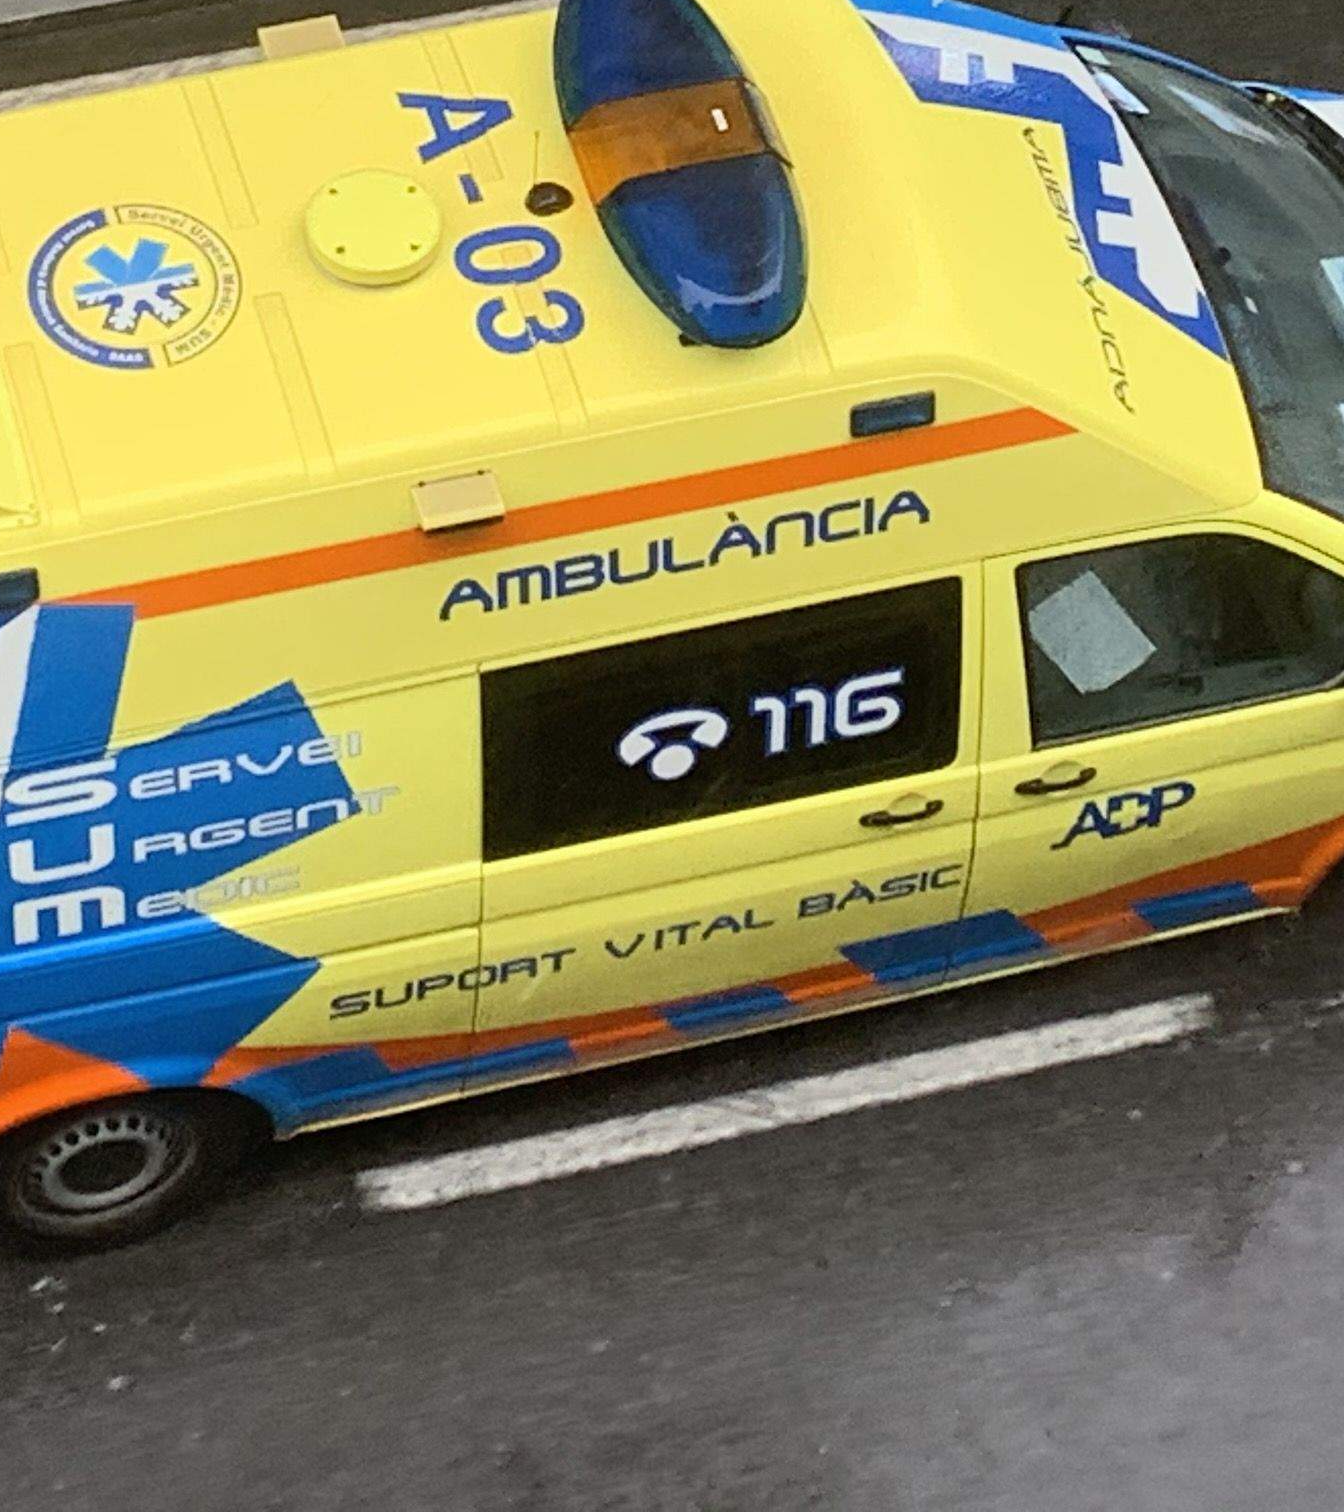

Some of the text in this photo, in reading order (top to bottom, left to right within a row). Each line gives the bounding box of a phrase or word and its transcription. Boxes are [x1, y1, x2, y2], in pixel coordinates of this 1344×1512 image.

[439, 489, 931, 621] AMBULÀNCIA
[751, 666, 907, 757] 116
[329, 863, 964, 1020] SUPORT VITAL BÀSIC
